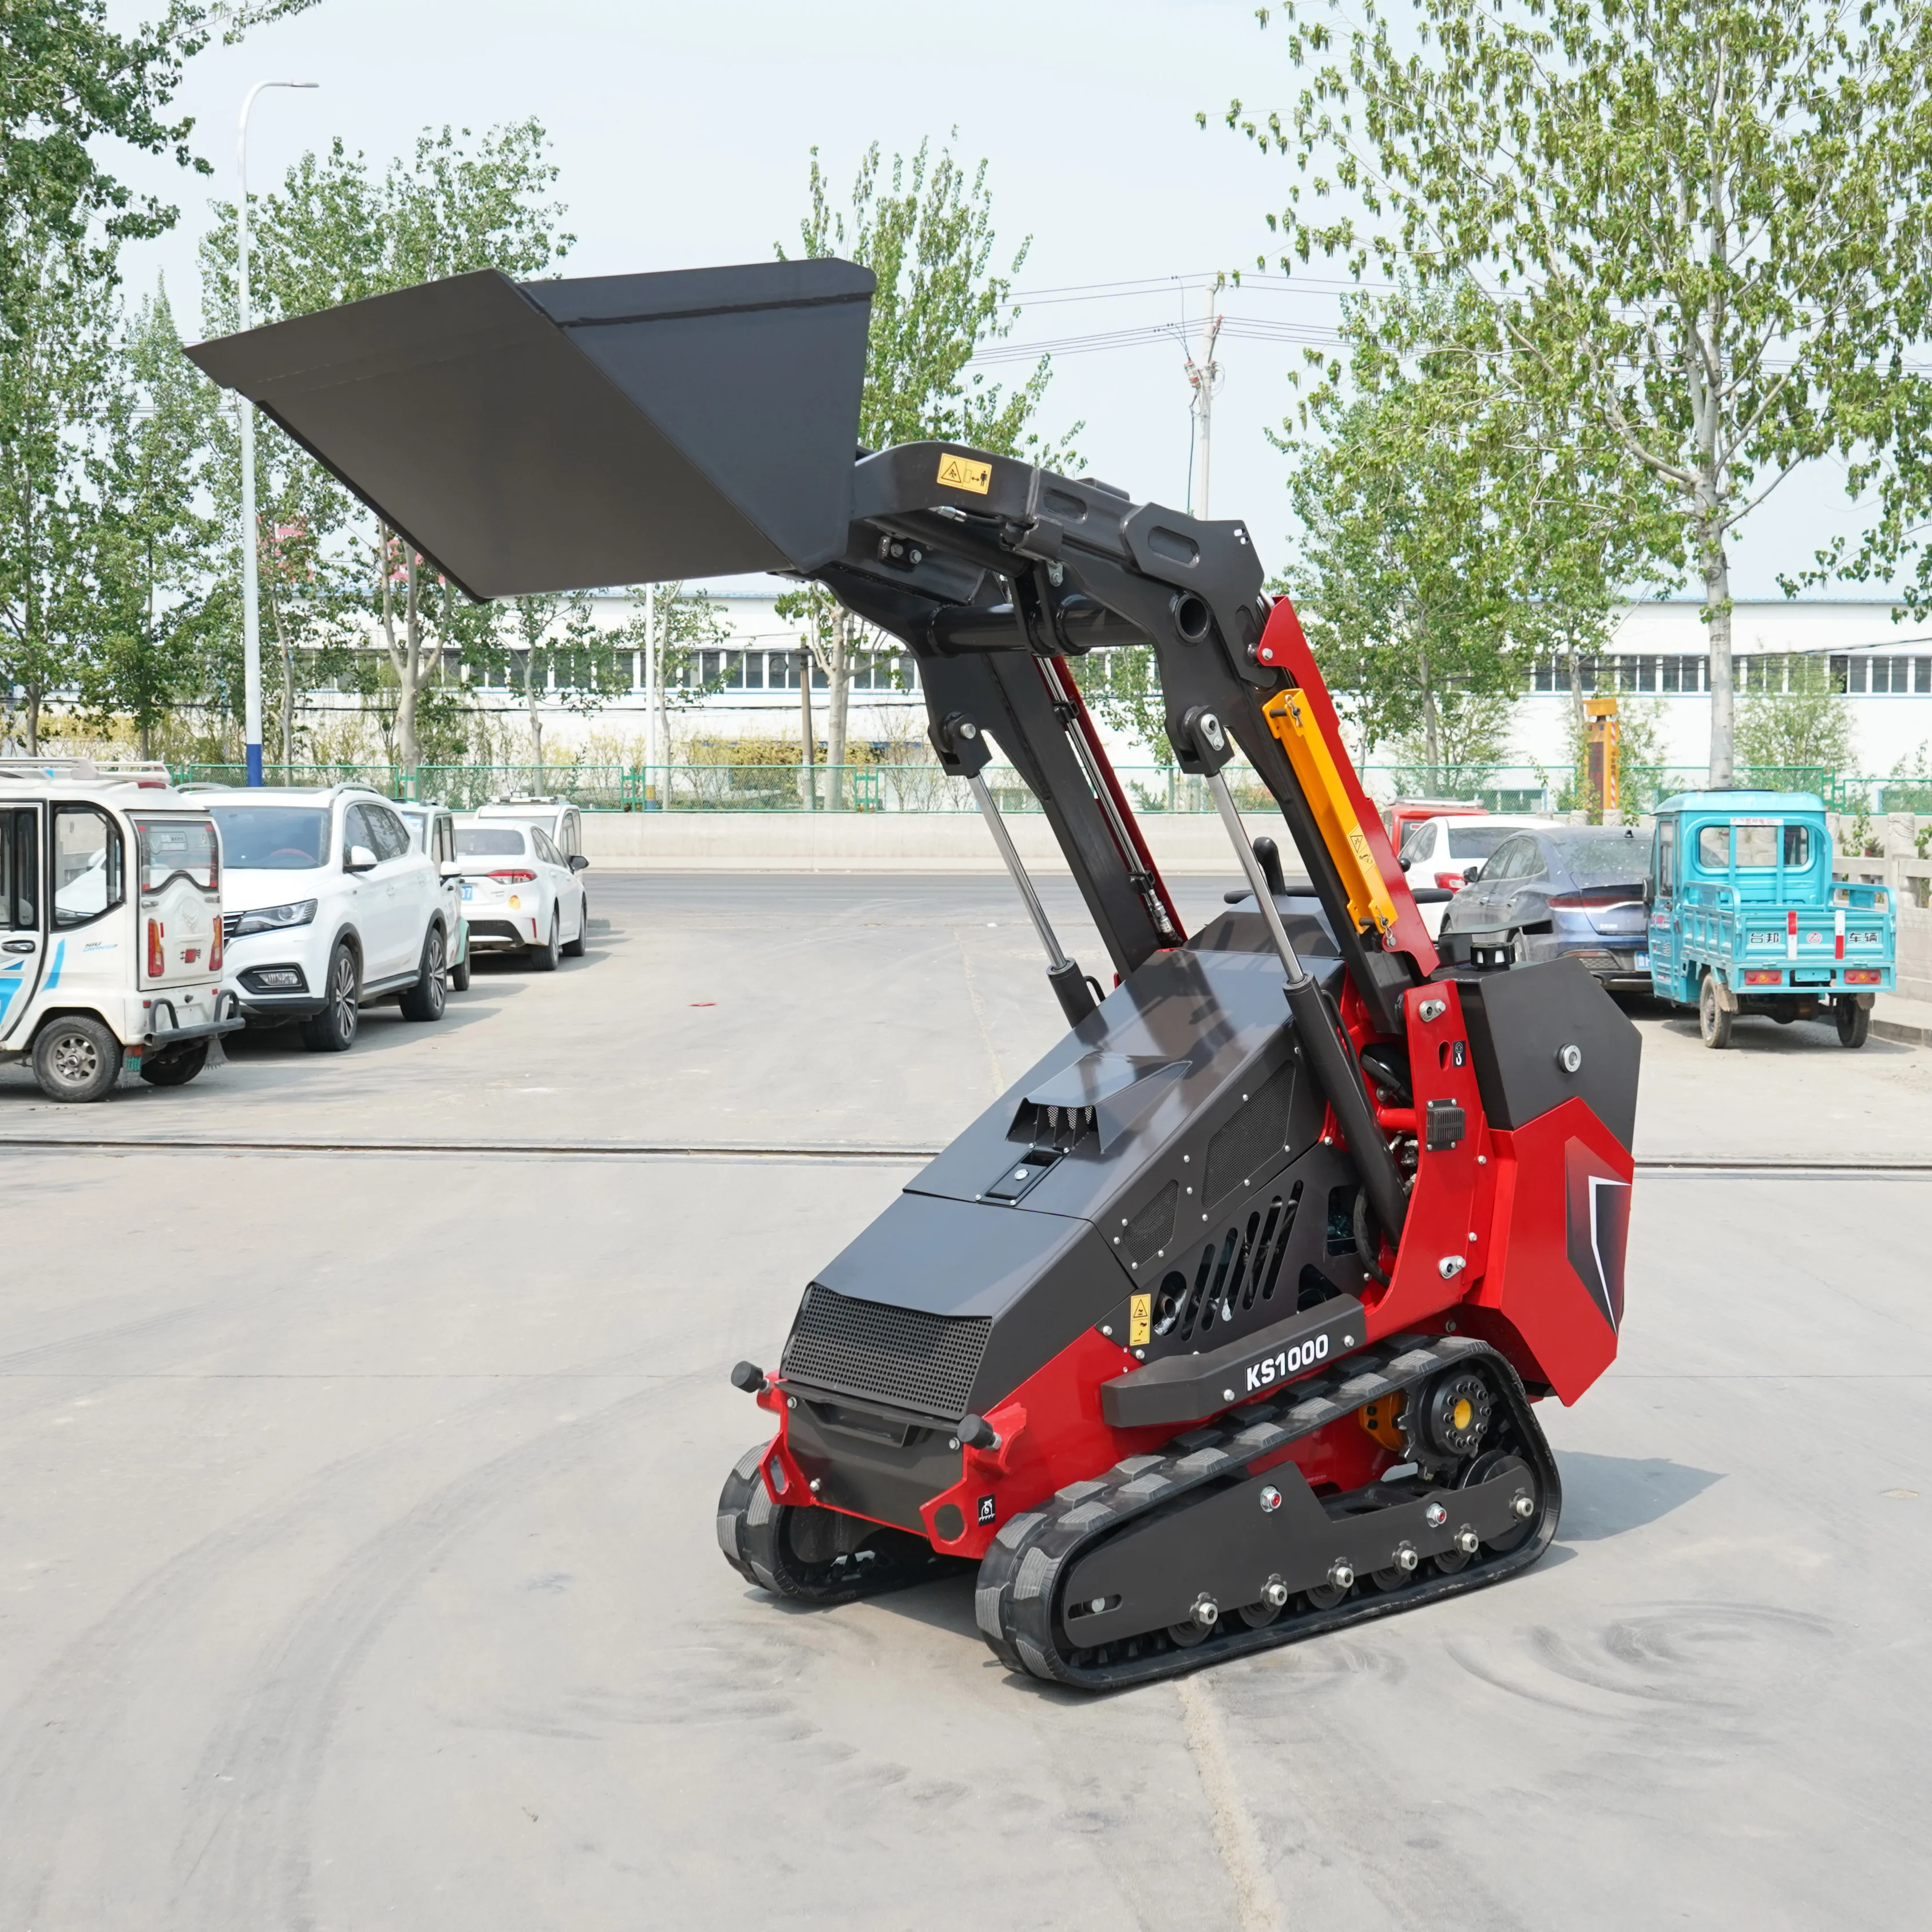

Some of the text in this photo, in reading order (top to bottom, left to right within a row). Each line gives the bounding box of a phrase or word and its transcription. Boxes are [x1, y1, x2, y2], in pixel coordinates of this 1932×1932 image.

[1751, 932, 1877, 944] 台邦 车辆
[1246, 1334, 1329, 1392] KS1000
